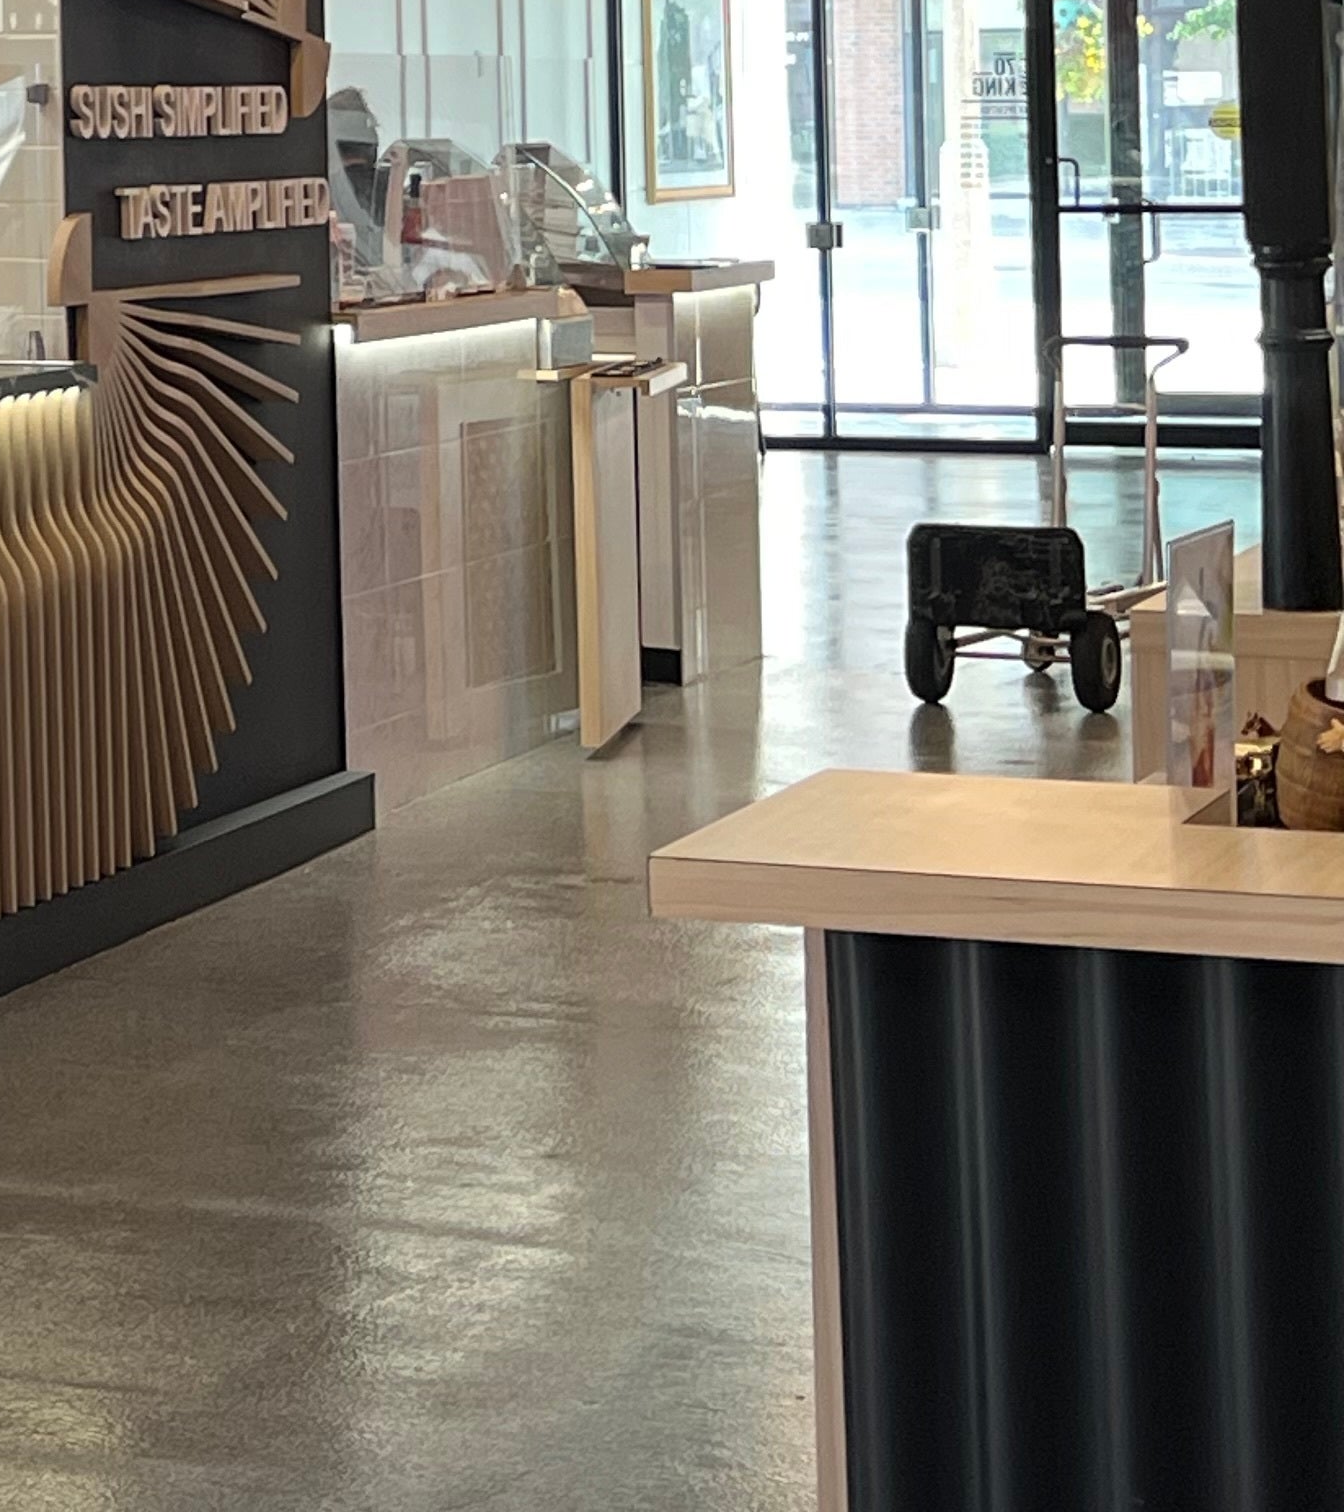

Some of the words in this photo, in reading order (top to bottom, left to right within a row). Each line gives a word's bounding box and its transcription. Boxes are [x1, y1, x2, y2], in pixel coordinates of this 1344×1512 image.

[69, 85, 154, 139] SUSHI
[154, 85, 289, 138] SIMPLIFIED
[115, 183, 204, 241] TASTE
[203, 177, 331, 235] AMPLIFIED
